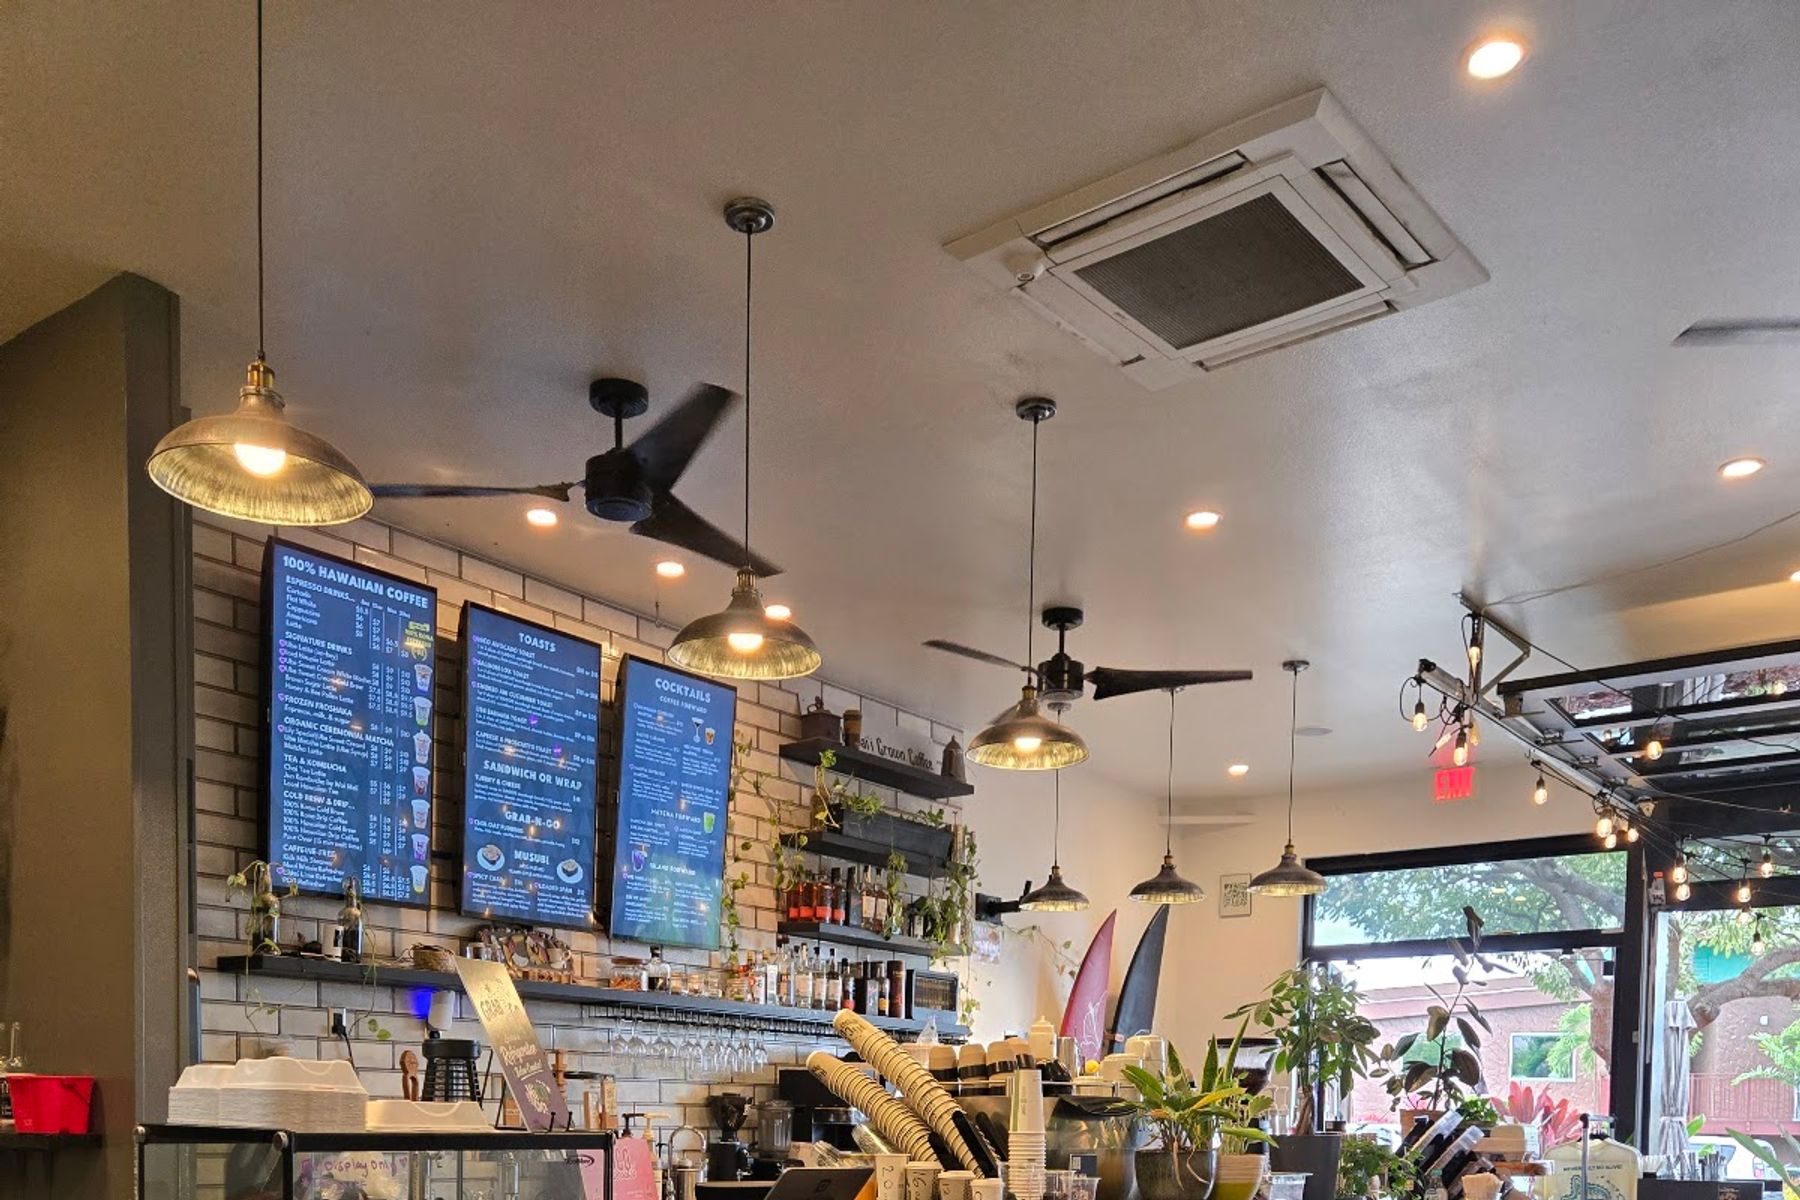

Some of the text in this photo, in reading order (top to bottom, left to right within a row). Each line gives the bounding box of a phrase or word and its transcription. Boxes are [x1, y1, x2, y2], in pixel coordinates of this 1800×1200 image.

[283, 554, 427, 608] 100% HAWAIIAN COFFEE
[285, 631, 351, 655] SIGNATURE DRINKS
[519, 632, 556, 652] TOASTS
[284, 694, 313, 708] FROZEN
[655, 677, 711, 703] COCKTAILS
[284, 715, 318, 730] ORGANIC
[365, 734, 393, 746] MATCHA
[876, 737, 906, 761] Grown
[284, 753, 298, 763] TEA
[306, 758, 346, 773] KOMBUCHA
[483, 760, 581, 790] SANDWICH OR WRAP
[283, 789, 303, 800] COLD
[305, 794, 324, 804] BREW
[505, 811, 560, 829] GRAB-N-GO
[514, 850, 549, 864] MUSUBI
